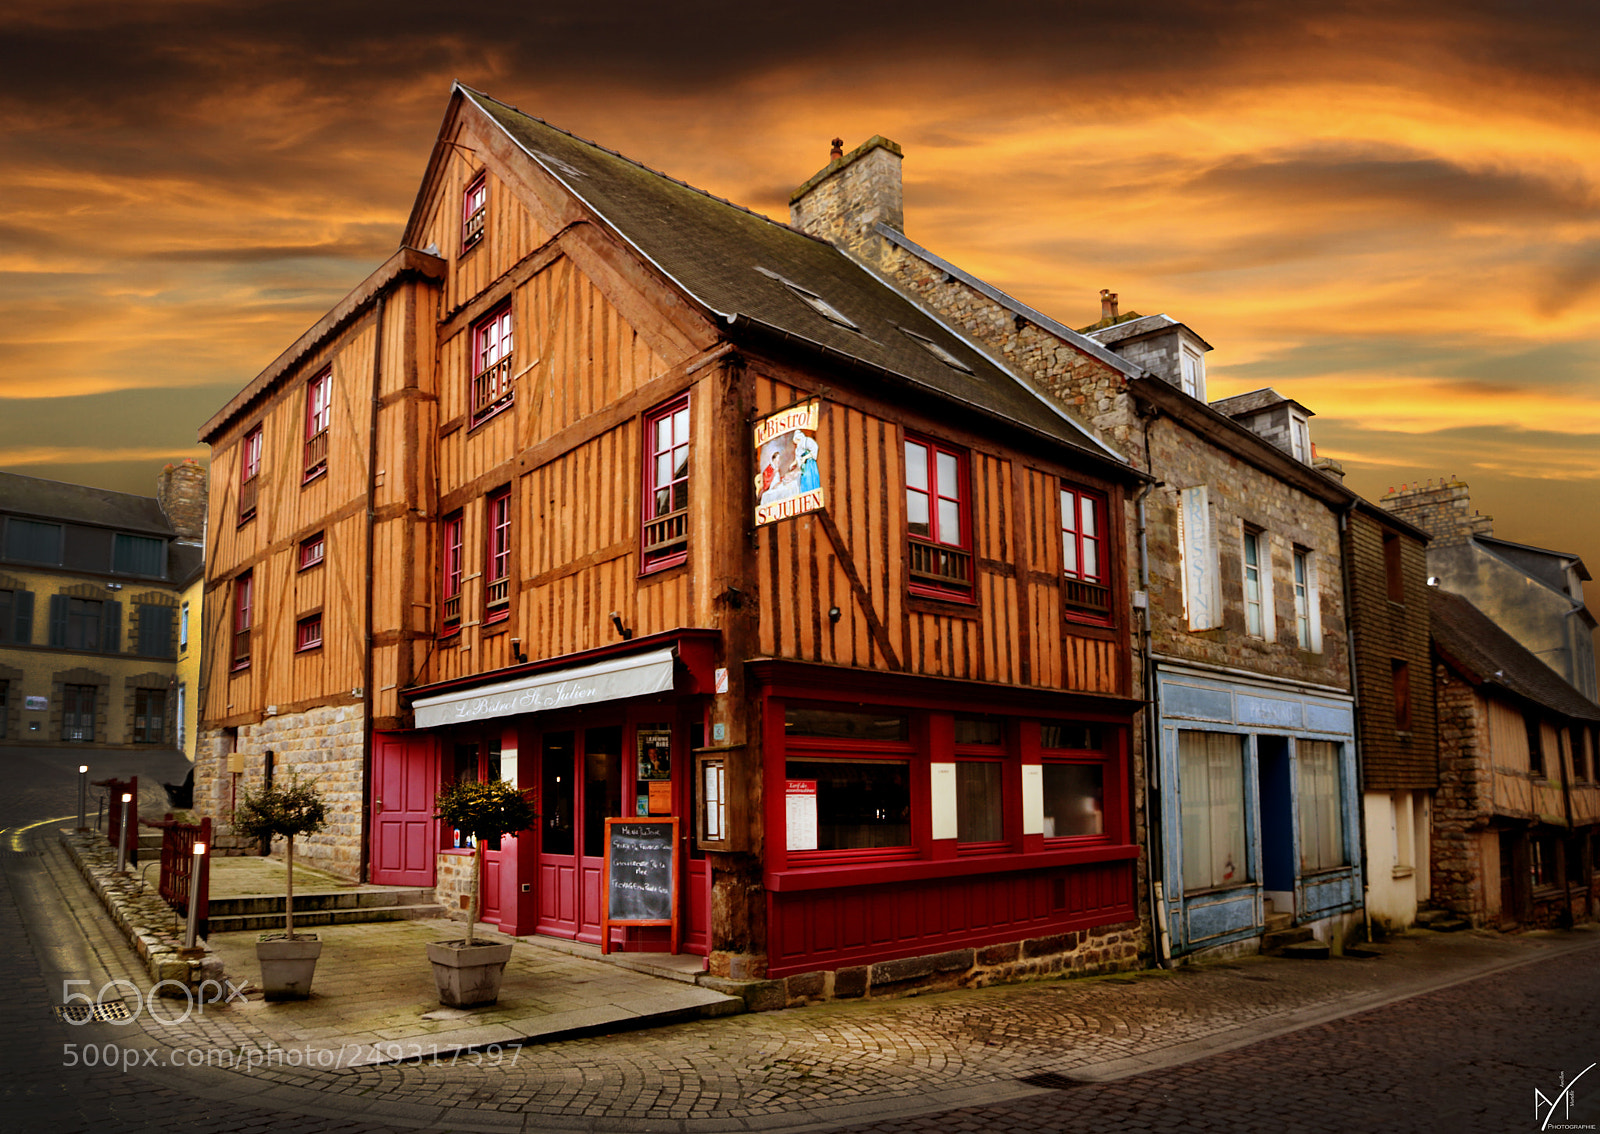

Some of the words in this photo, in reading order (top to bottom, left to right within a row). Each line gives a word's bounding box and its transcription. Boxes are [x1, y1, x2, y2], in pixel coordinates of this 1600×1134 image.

[766, 411, 812, 437] Bistrot
[774, 492, 820, 520] JULIEN
[1189, 487, 1209, 629] PRESSING
[455, 704, 470, 718] Le
[471, 697, 517, 715] Bistrot
[544, 682, 597, 707] Julien
